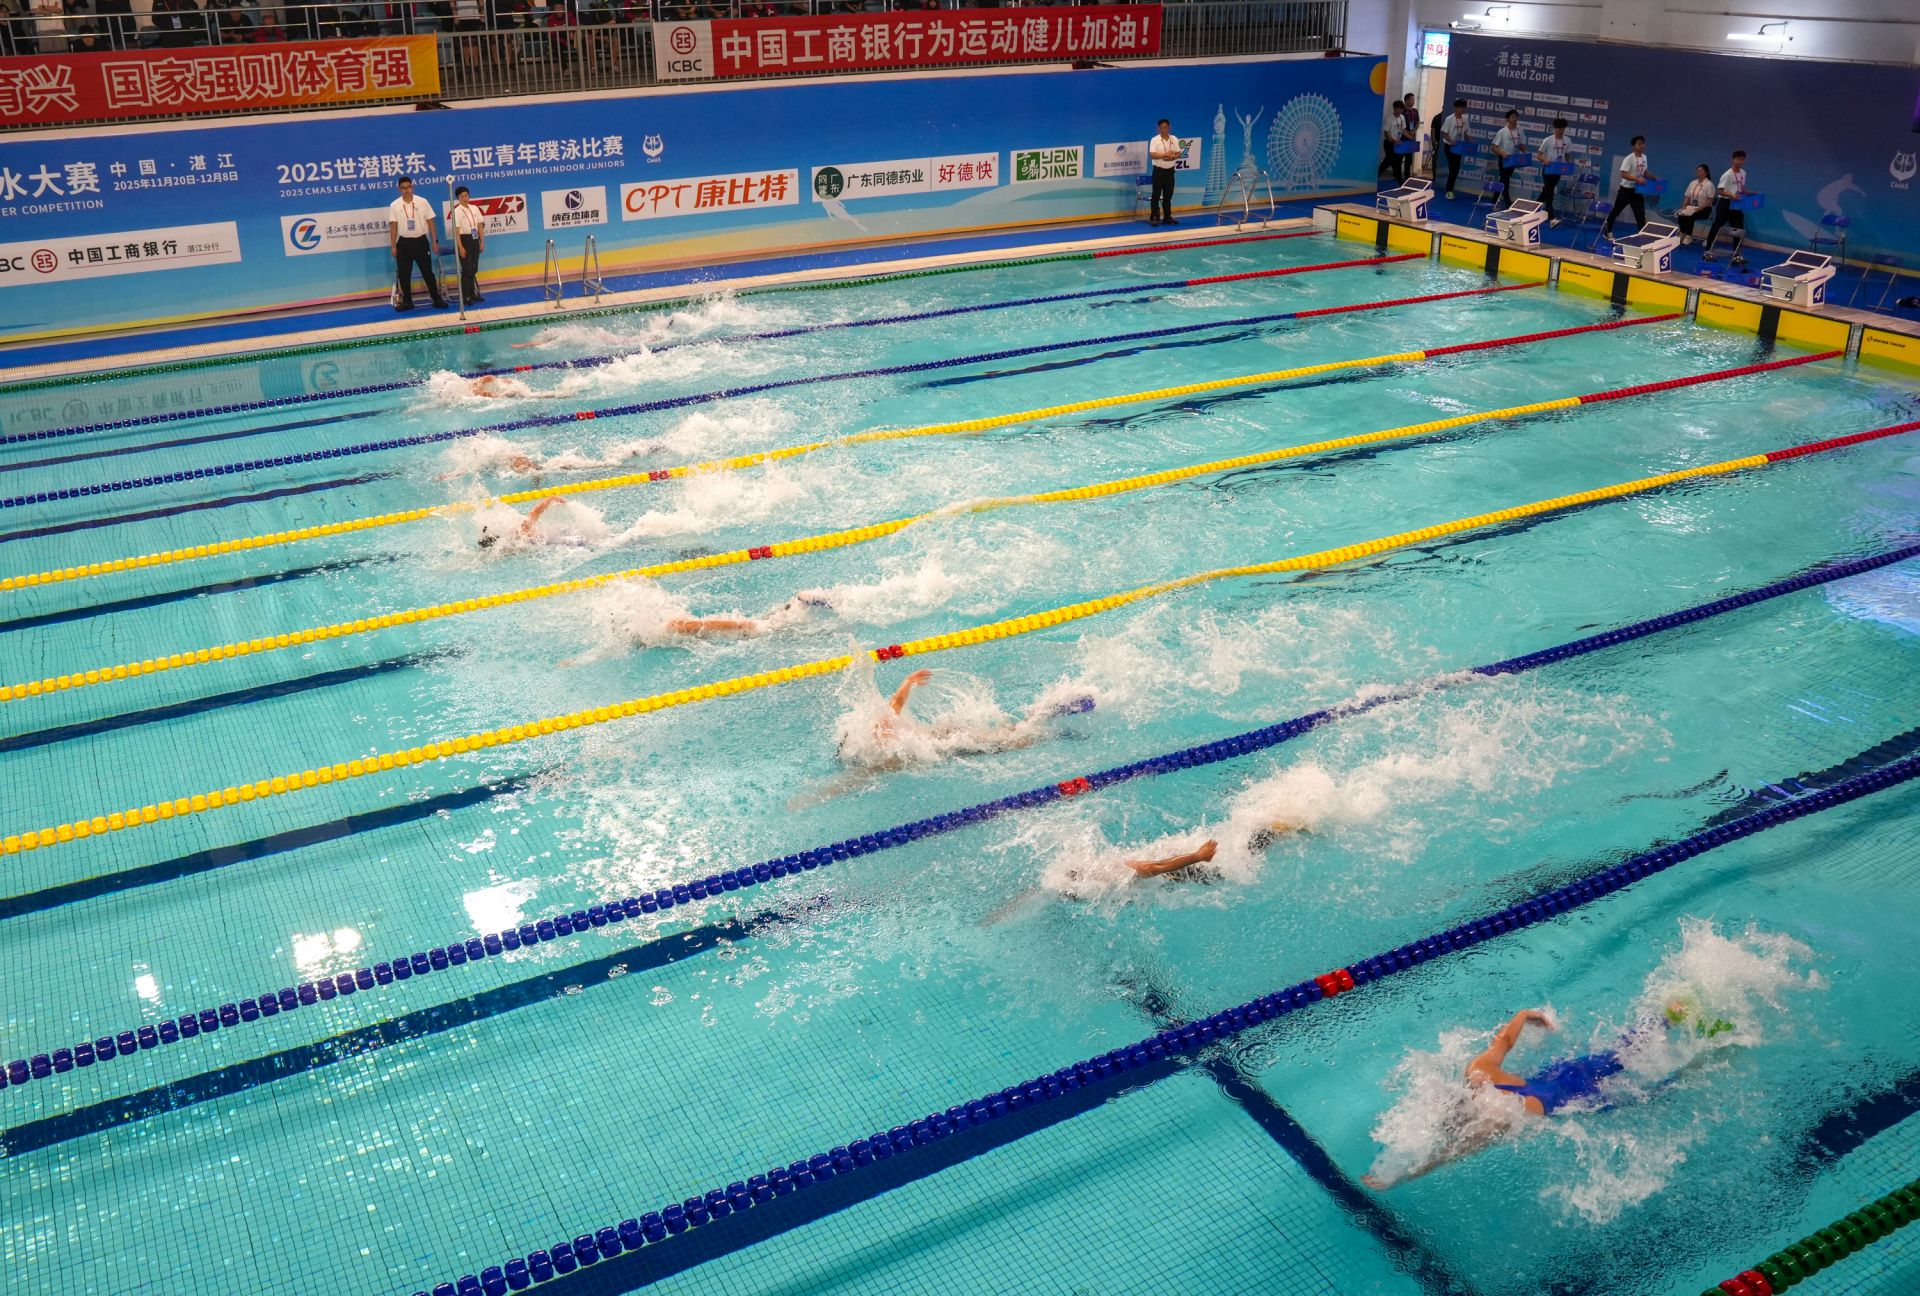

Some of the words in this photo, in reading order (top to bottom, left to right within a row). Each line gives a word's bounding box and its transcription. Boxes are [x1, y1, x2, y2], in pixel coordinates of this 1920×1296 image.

[720, 13, 1150, 70] 中国工商银行为运动健儿加油!
[667, 59, 703, 74] ICBC
[1499, 51, 1557, 70] 混合采访区
[101, 46, 414, 109] 国家强则体育强
[1497, 66, 1528, 81] Mixed
[1528, 69, 1556, 83] Zone
[113, 170, 239, 192] 2025年11月20日-12月8日
[280, 188, 304, 198] 2025
[305, 185, 332, 196] CMAS
[334, 183, 358, 193] EAST
[359, 183, 368, 191] &
[368, 180, 394, 191] WEST
[418, 171, 484, 185] COMPTITION
[485, 166, 549, 179] FINSWIMMING
[549, 162, 585, 174] INDOOR
[586, 158, 625, 170] JUNIORS
[847, 168, 924, 189] 广东同德药业
[938, 160, 993, 184] 好德快
[625, 184, 692, 215] CPT
[694, 173, 789, 209] 康比特
[21, 199, 104, 216] COMPETITION
[1417, 205, 1424, 217] 1
[1529, 229, 1538, 241] 2
[68, 239, 178, 265] 中国工商银行
[1661, 256, 1669, 270] 3
[1813, 286, 1823, 301] 4
